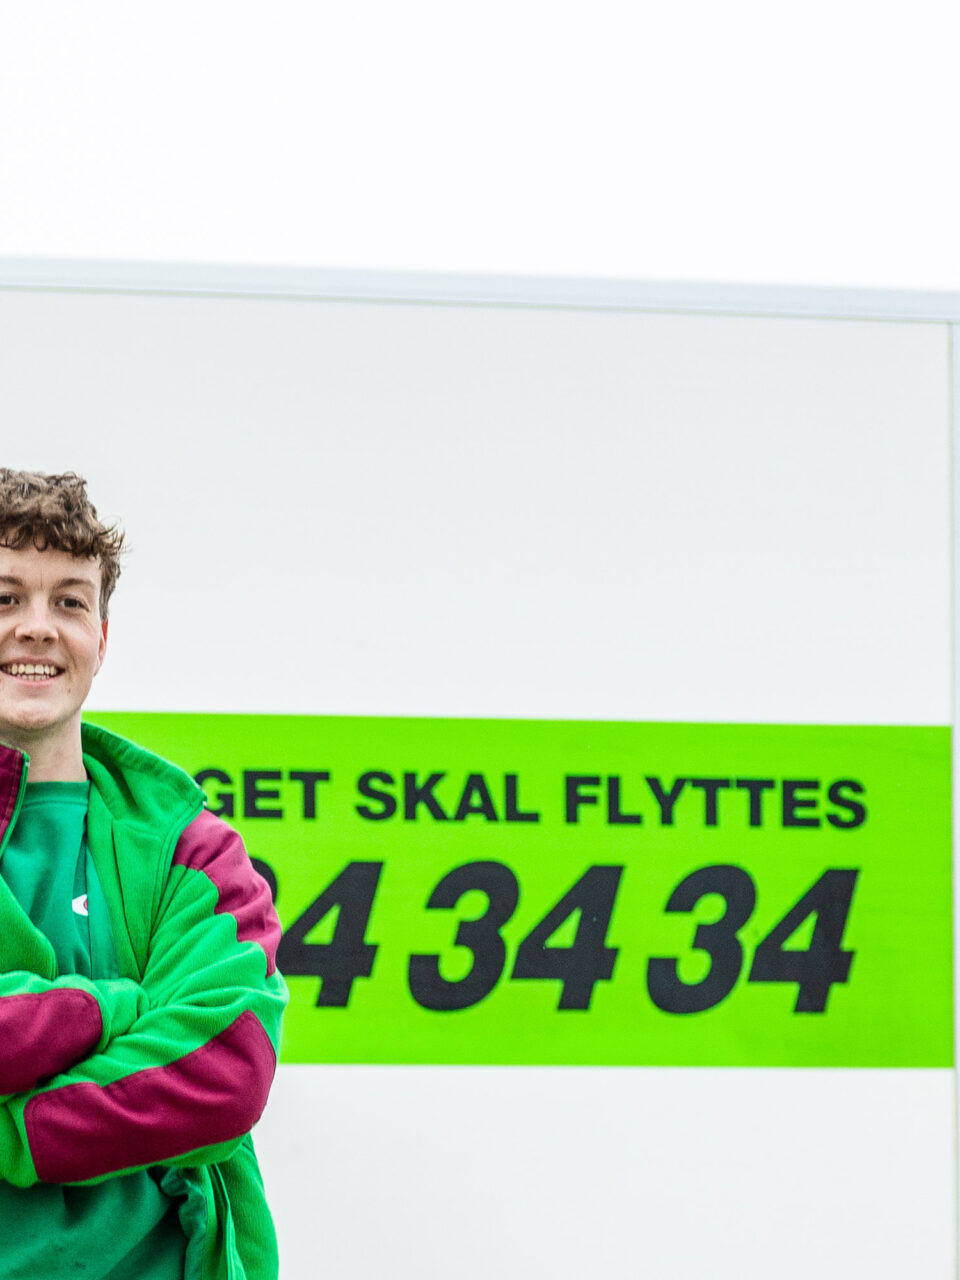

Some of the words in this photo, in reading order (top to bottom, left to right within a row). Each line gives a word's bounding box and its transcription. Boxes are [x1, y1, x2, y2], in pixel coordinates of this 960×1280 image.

[355, 770, 541, 824] SKAL
[564, 774, 869, 831] FLYTTES
[249, 857, 385, 1010] 4
[406, 860, 625, 1013] 34
[645, 863, 862, 1016] 34
